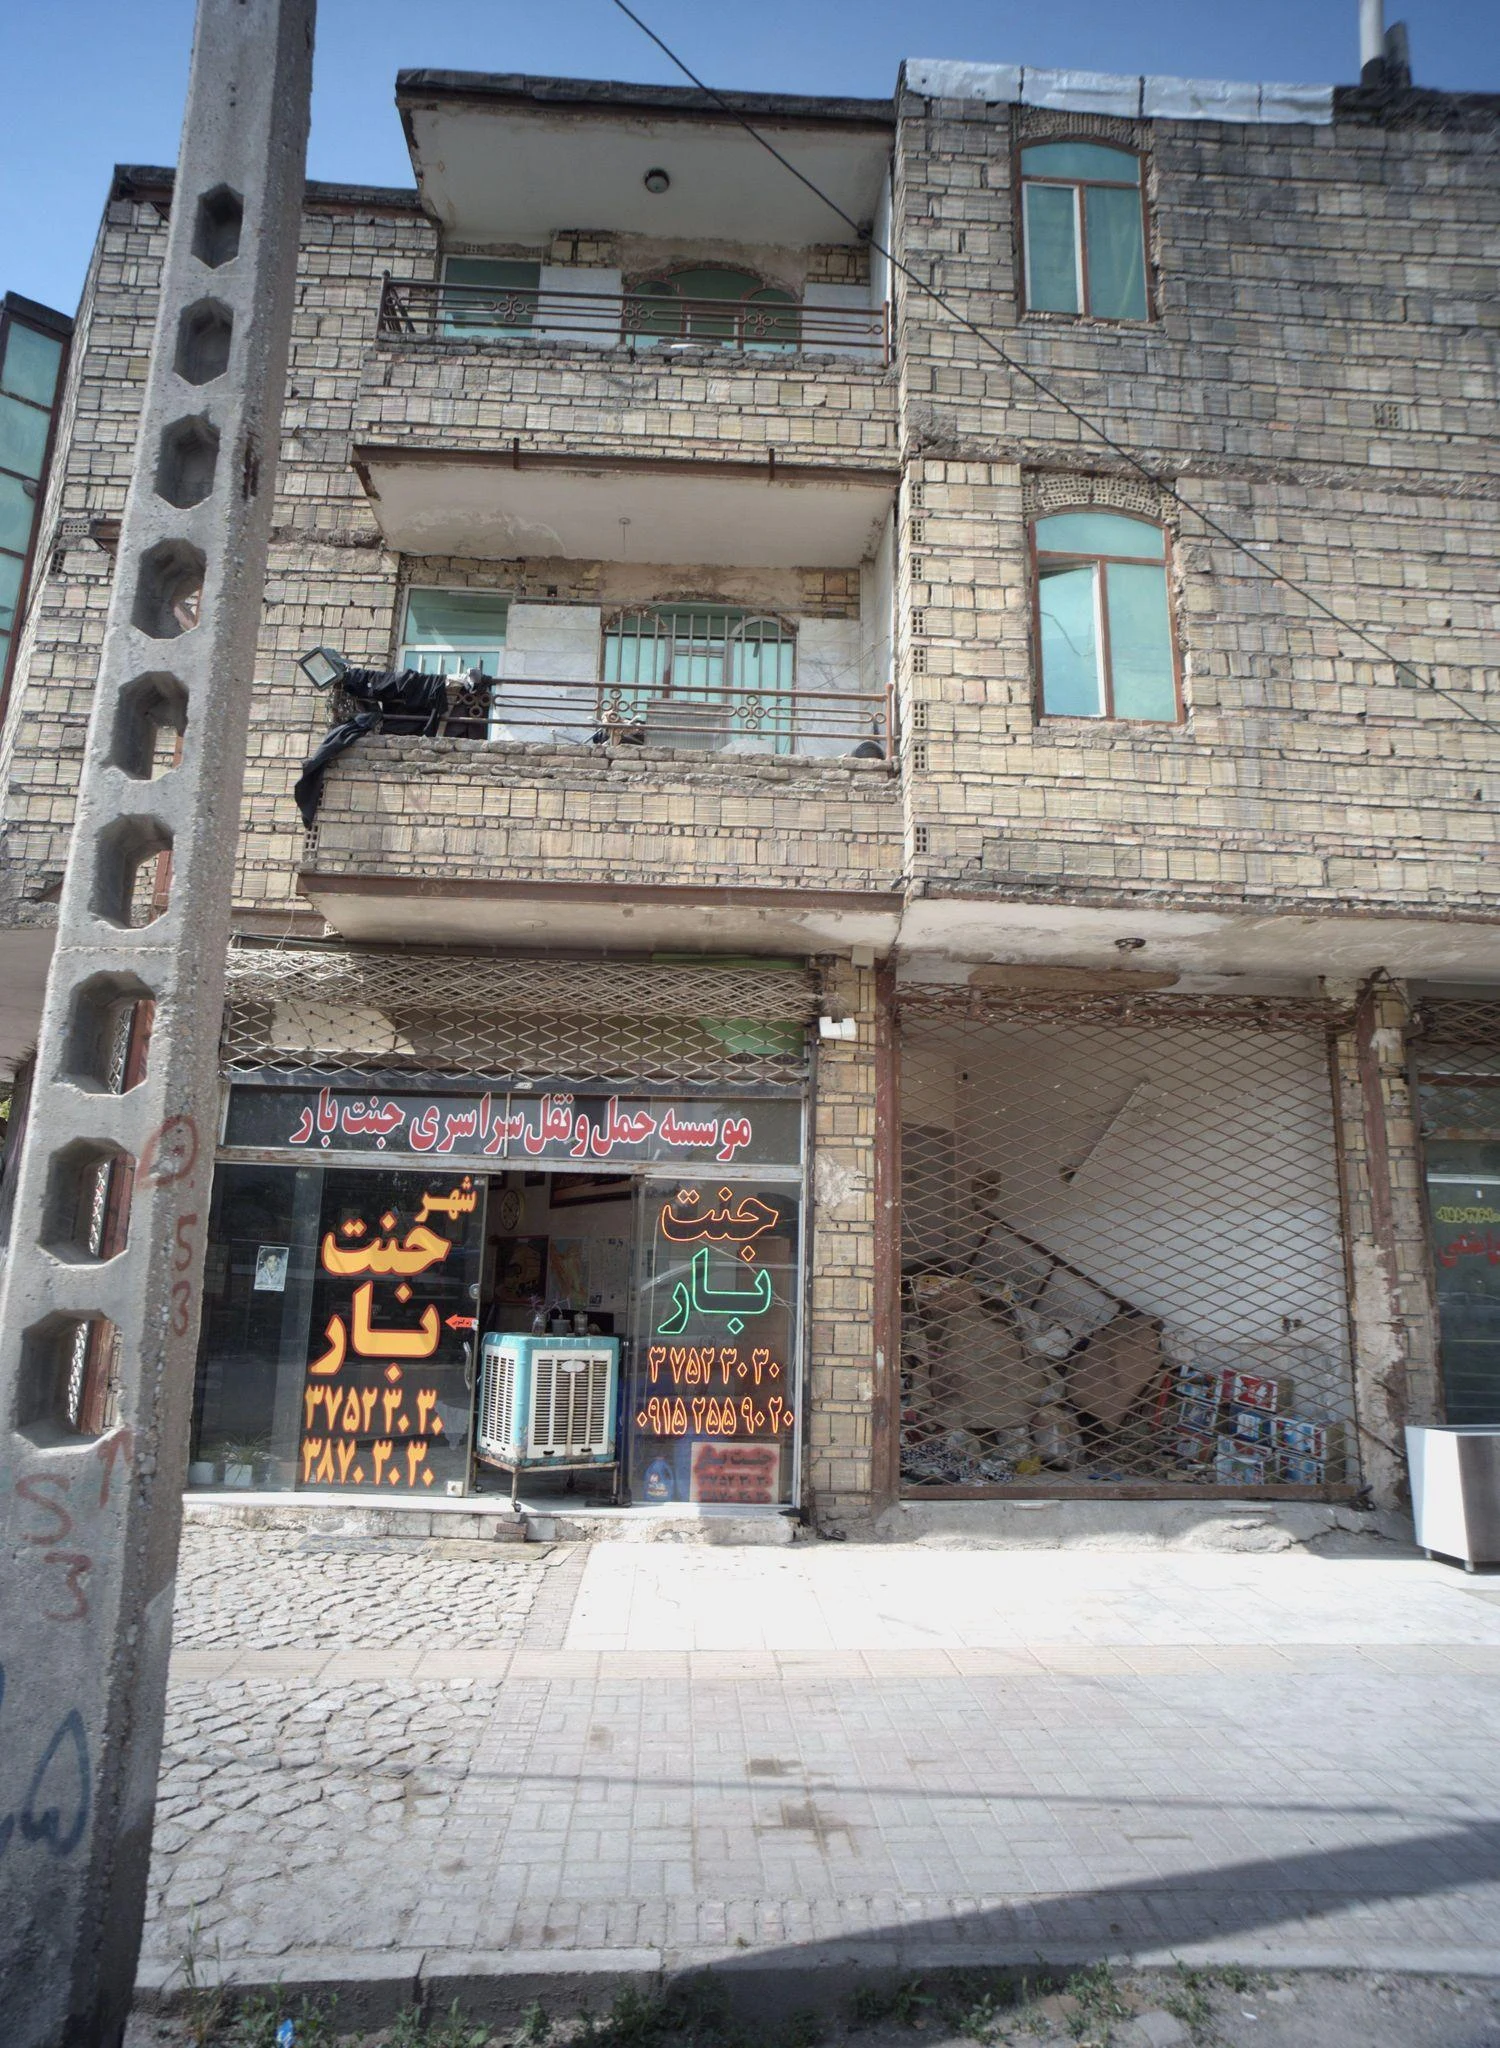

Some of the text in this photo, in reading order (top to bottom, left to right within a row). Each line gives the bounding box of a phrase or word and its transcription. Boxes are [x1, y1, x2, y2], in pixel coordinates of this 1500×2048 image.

[289, 1086, 339, 1148] بار
[342, 1096, 406, 1149] جنت
[409, 1091, 525, 1155] سراسری
[591, 1095, 657, 1156] حمل
[659, 1108, 752, 1161] موسسه
[414, 1175, 477, 1222] شهر
[661, 1187, 779, 1262] جنت
[321, 1211, 452, 1303] جنت
[657, 1247, 772, 1334] بار
[307, 1280, 441, 1383] بار
